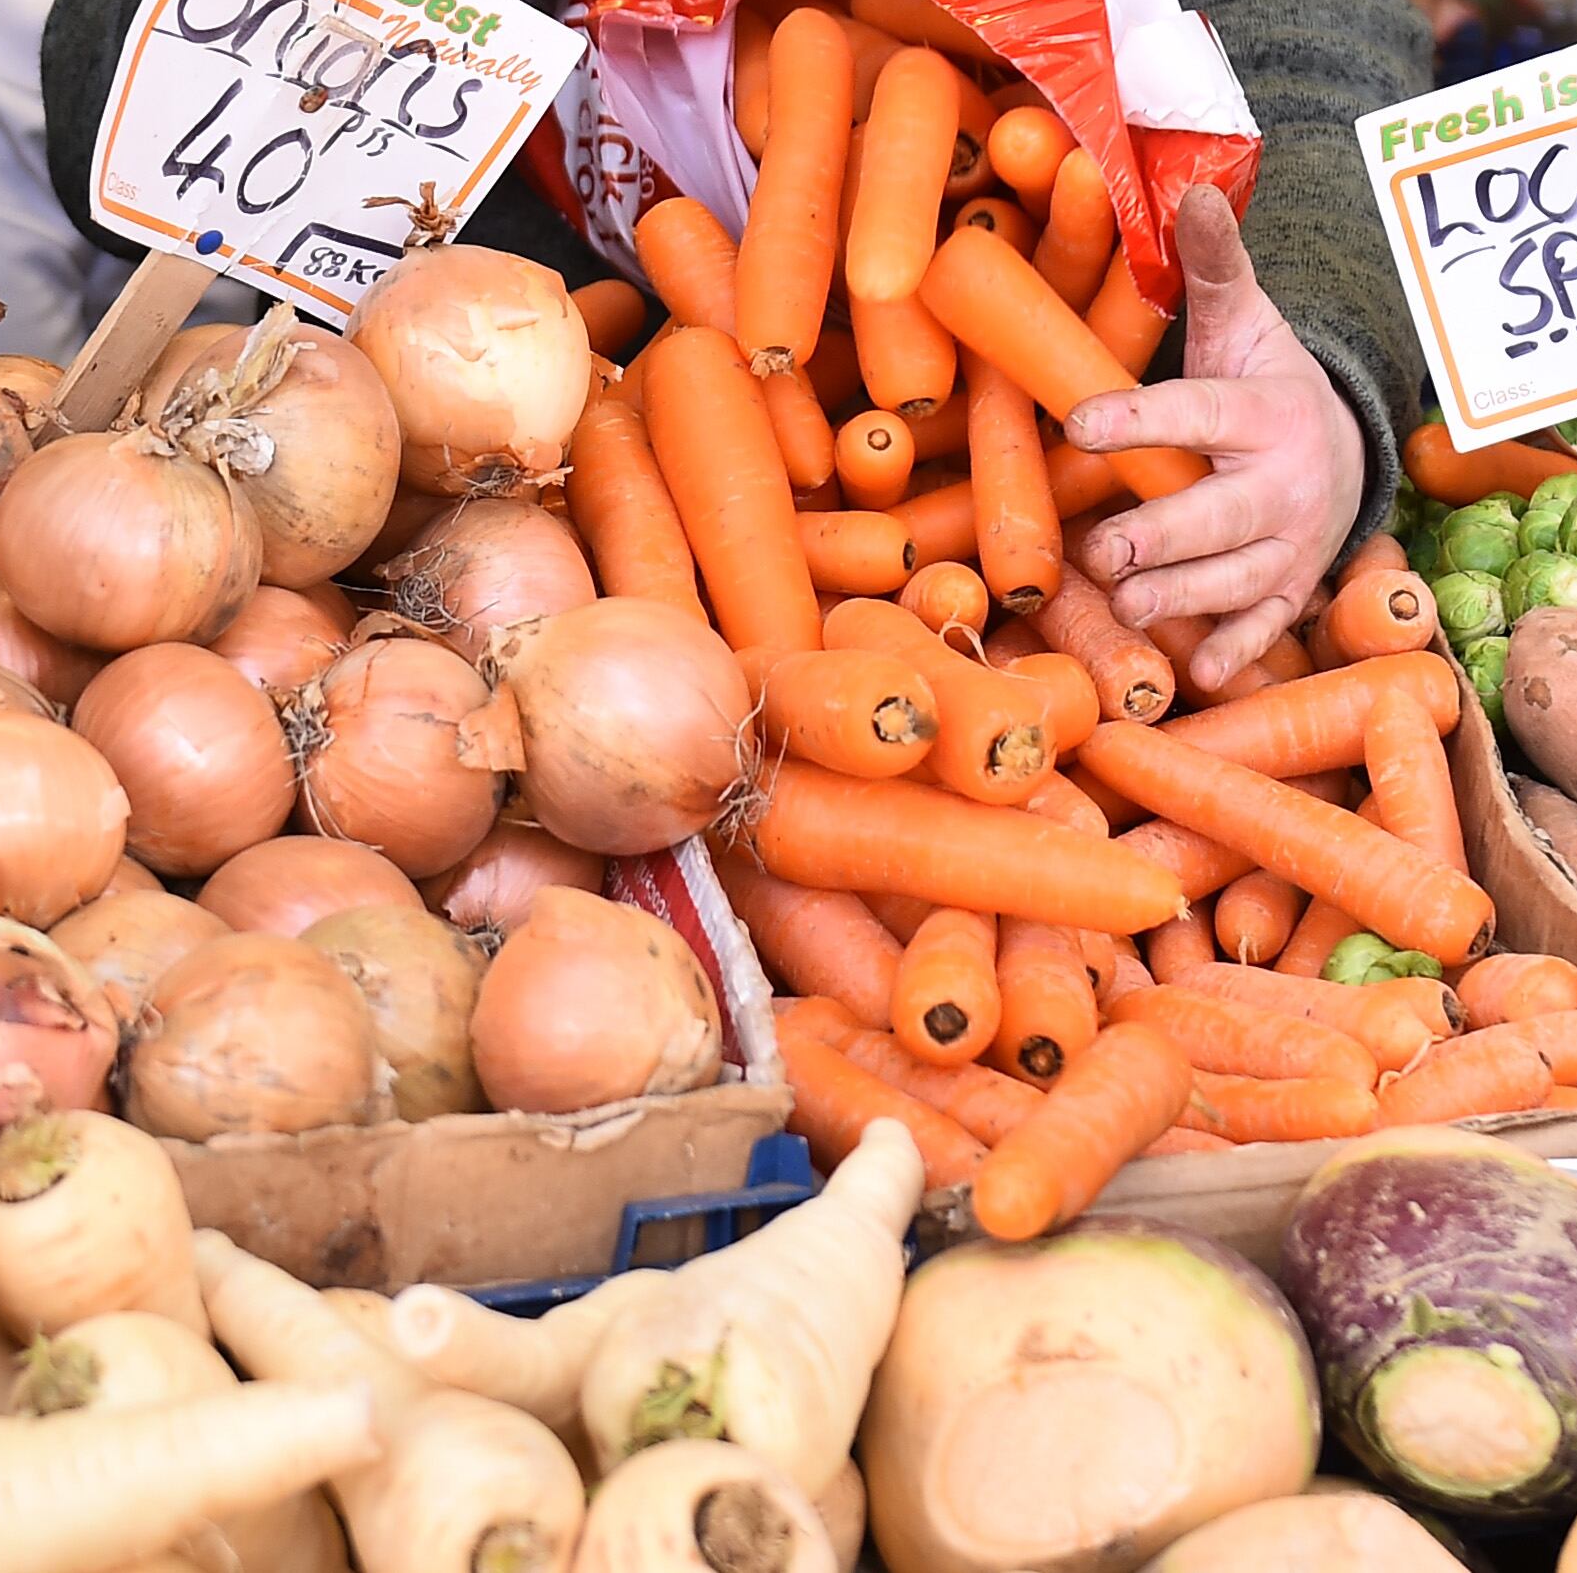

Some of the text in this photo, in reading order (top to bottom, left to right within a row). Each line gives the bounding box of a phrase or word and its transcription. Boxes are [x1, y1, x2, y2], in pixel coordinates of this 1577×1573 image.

[378, 12, 545, 95] Naturally
[162, 78, 314, 215] 40
[1379, 86, 1526, 163] Fresh
[1472, 379, 1538, 412] Class:
